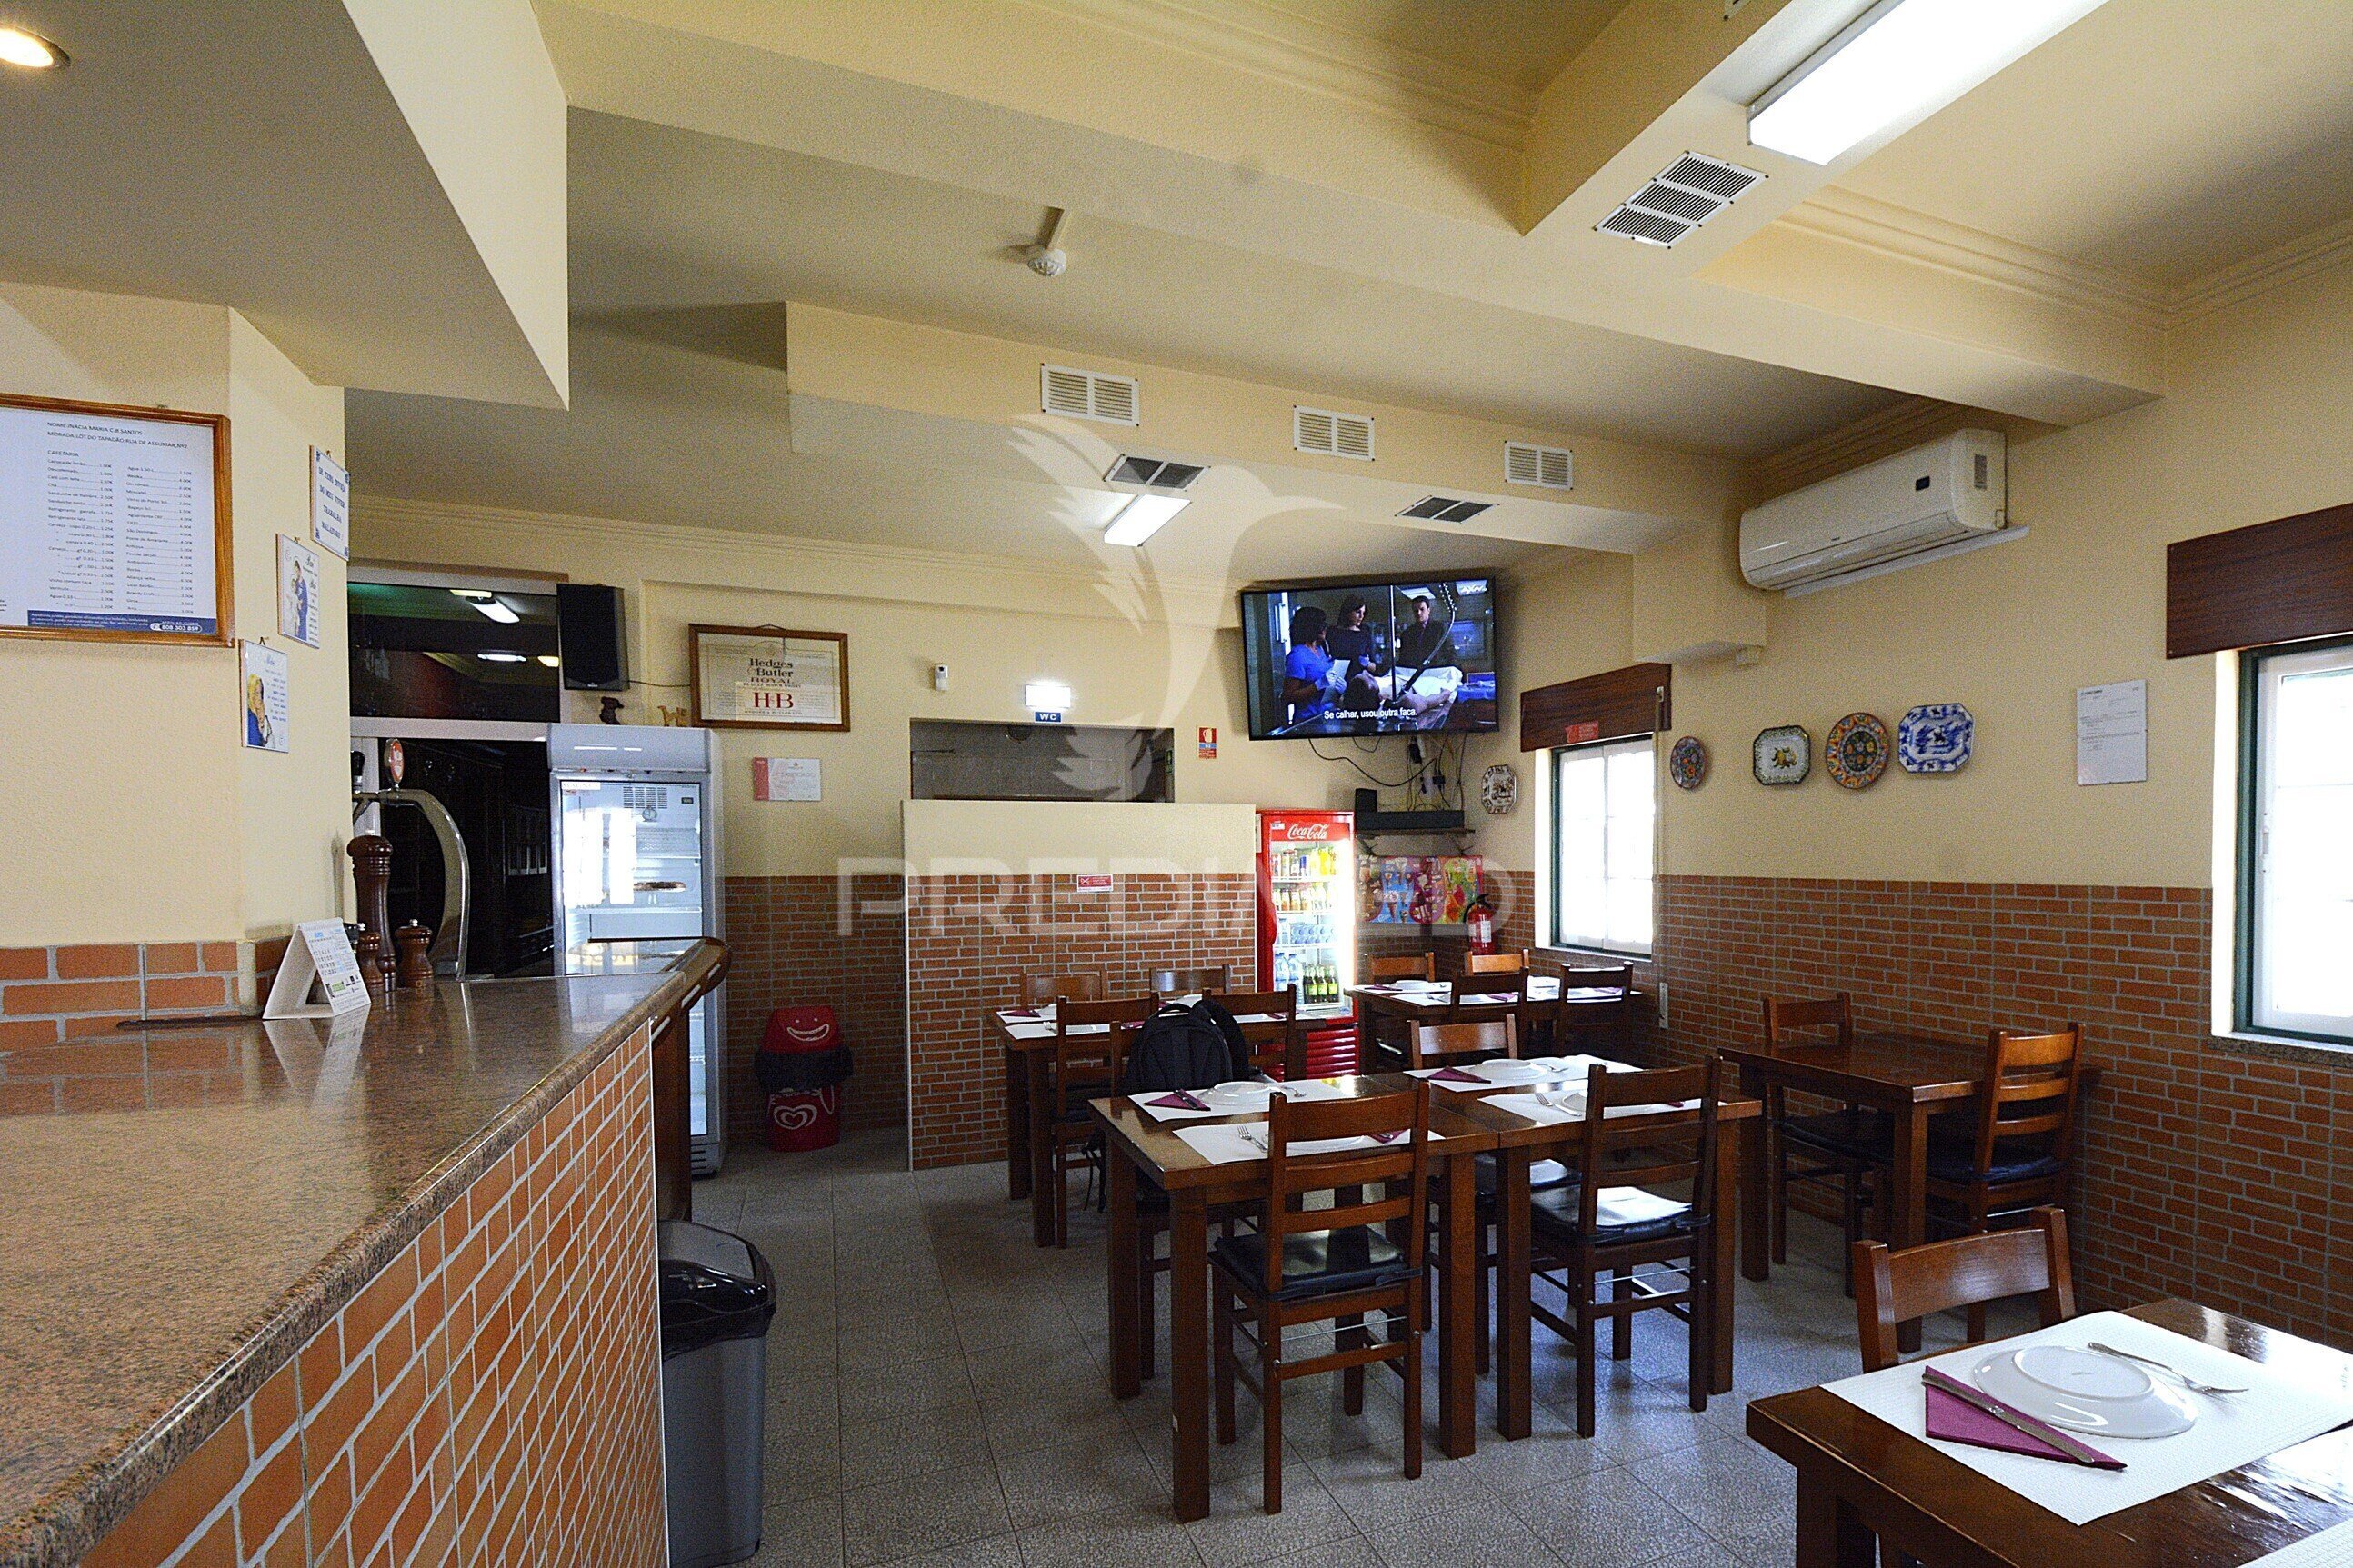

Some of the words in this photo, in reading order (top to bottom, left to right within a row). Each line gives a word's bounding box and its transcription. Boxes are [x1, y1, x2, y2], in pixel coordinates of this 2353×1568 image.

[750, 658, 793, 669] Hedges
[756, 668, 793, 677] Butler
[1325, 711, 1334, 720] Se
[1336, 710, 1359, 719] calhar,
[1379, 709, 1398, 718] outra
